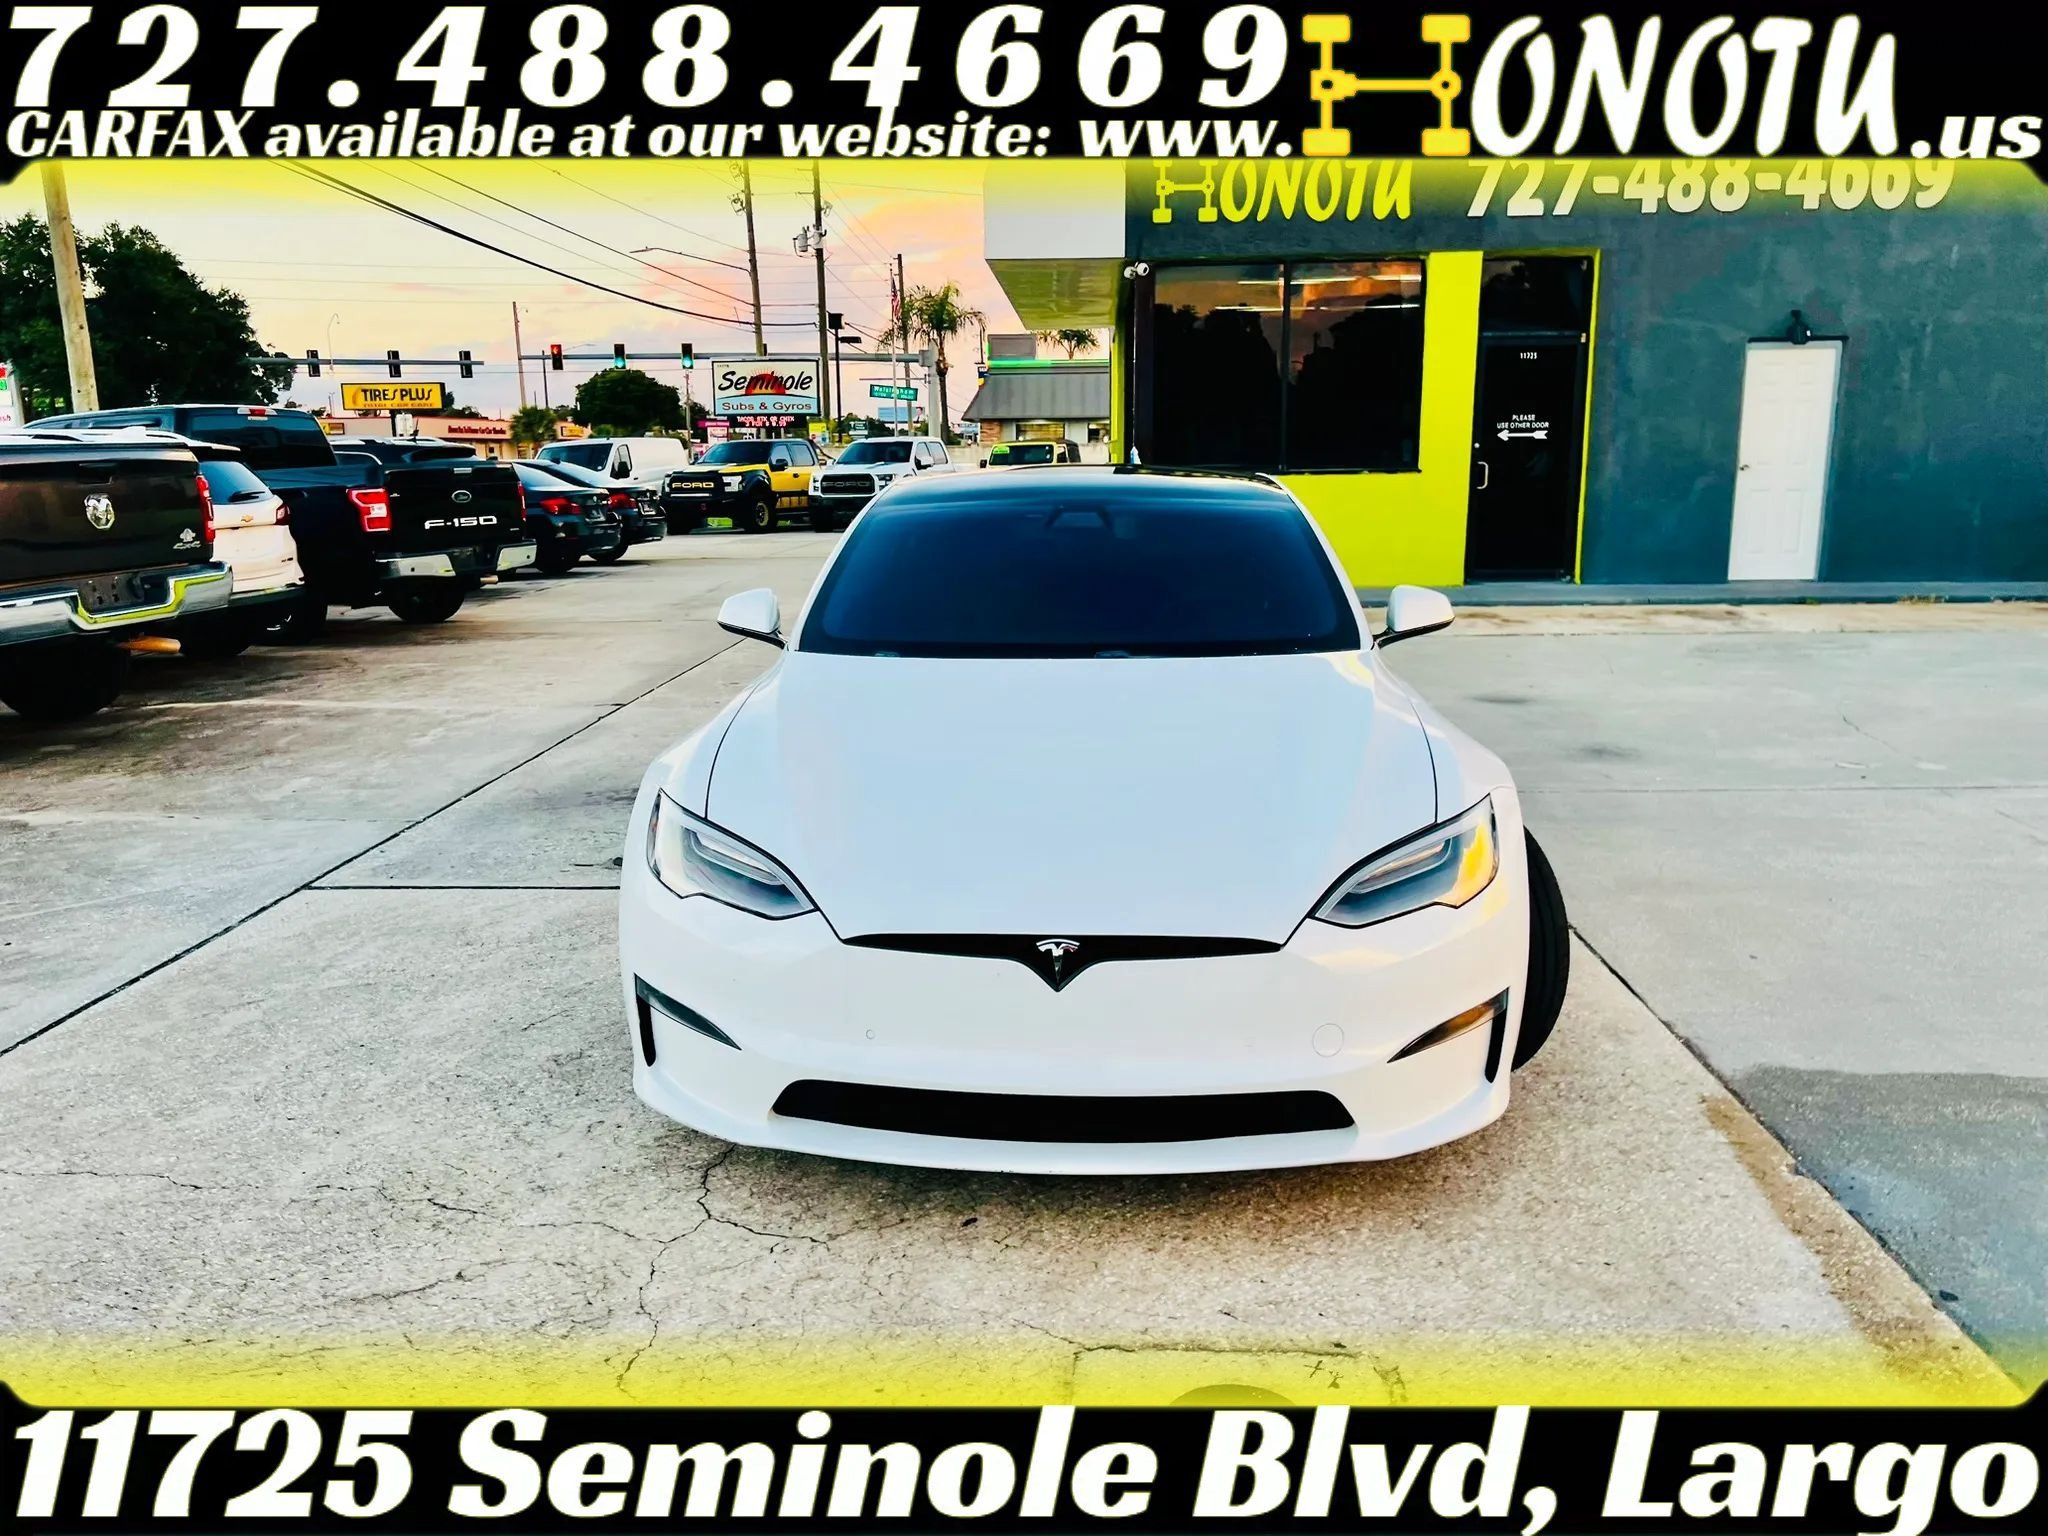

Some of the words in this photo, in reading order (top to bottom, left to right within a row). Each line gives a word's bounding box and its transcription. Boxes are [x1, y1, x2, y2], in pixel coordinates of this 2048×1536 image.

[1520, 352, 1538, 360] 11725
[718, 370, 813, 391] Seminole
[361, 388, 398, 401] TIRES
[400, 388, 432, 401] PLUS
[722, 402, 754, 410] Subs
[759, 402, 768, 410] &
[773, 402, 812, 412] Gyros
[424, 515, 498, 530] F-150
